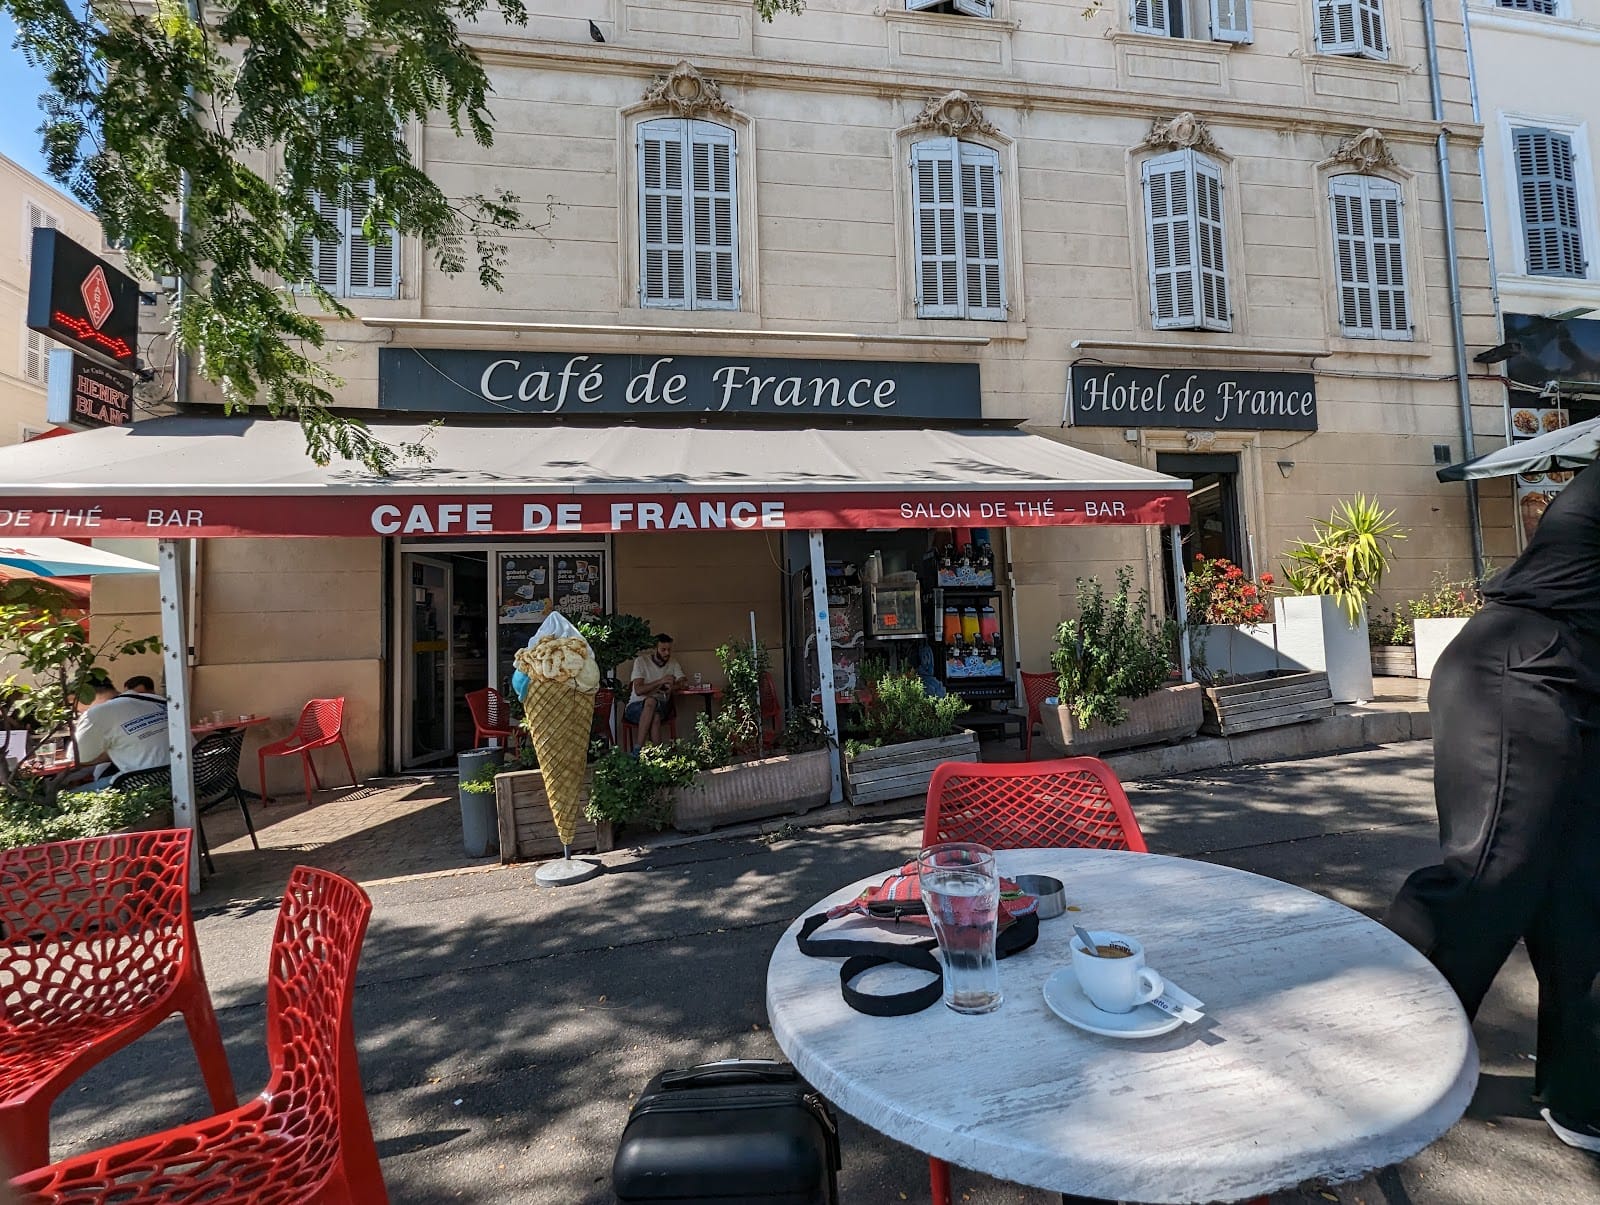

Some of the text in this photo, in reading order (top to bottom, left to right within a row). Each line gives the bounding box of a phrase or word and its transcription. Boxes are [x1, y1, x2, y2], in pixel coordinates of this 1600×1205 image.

[93, 276, 102, 319] TABAC
[77, 374, 130, 409] HENRY
[480, 355, 897, 413] Café de France
[1080, 372, 1314, 422] Hotel de France
[47, 505, 102, 527] THÉ
[147, 509, 204, 527] BAR
[371, 502, 785, 534] CAFE DE FRANCE
[900, 503, 970, 518] SALON
[980, 503, 1007, 518] DE
[1015, 498, 1055, 517] THÉ
[1085, 501, 1125, 516] BAR
[559, 594, 590, 607] glace
